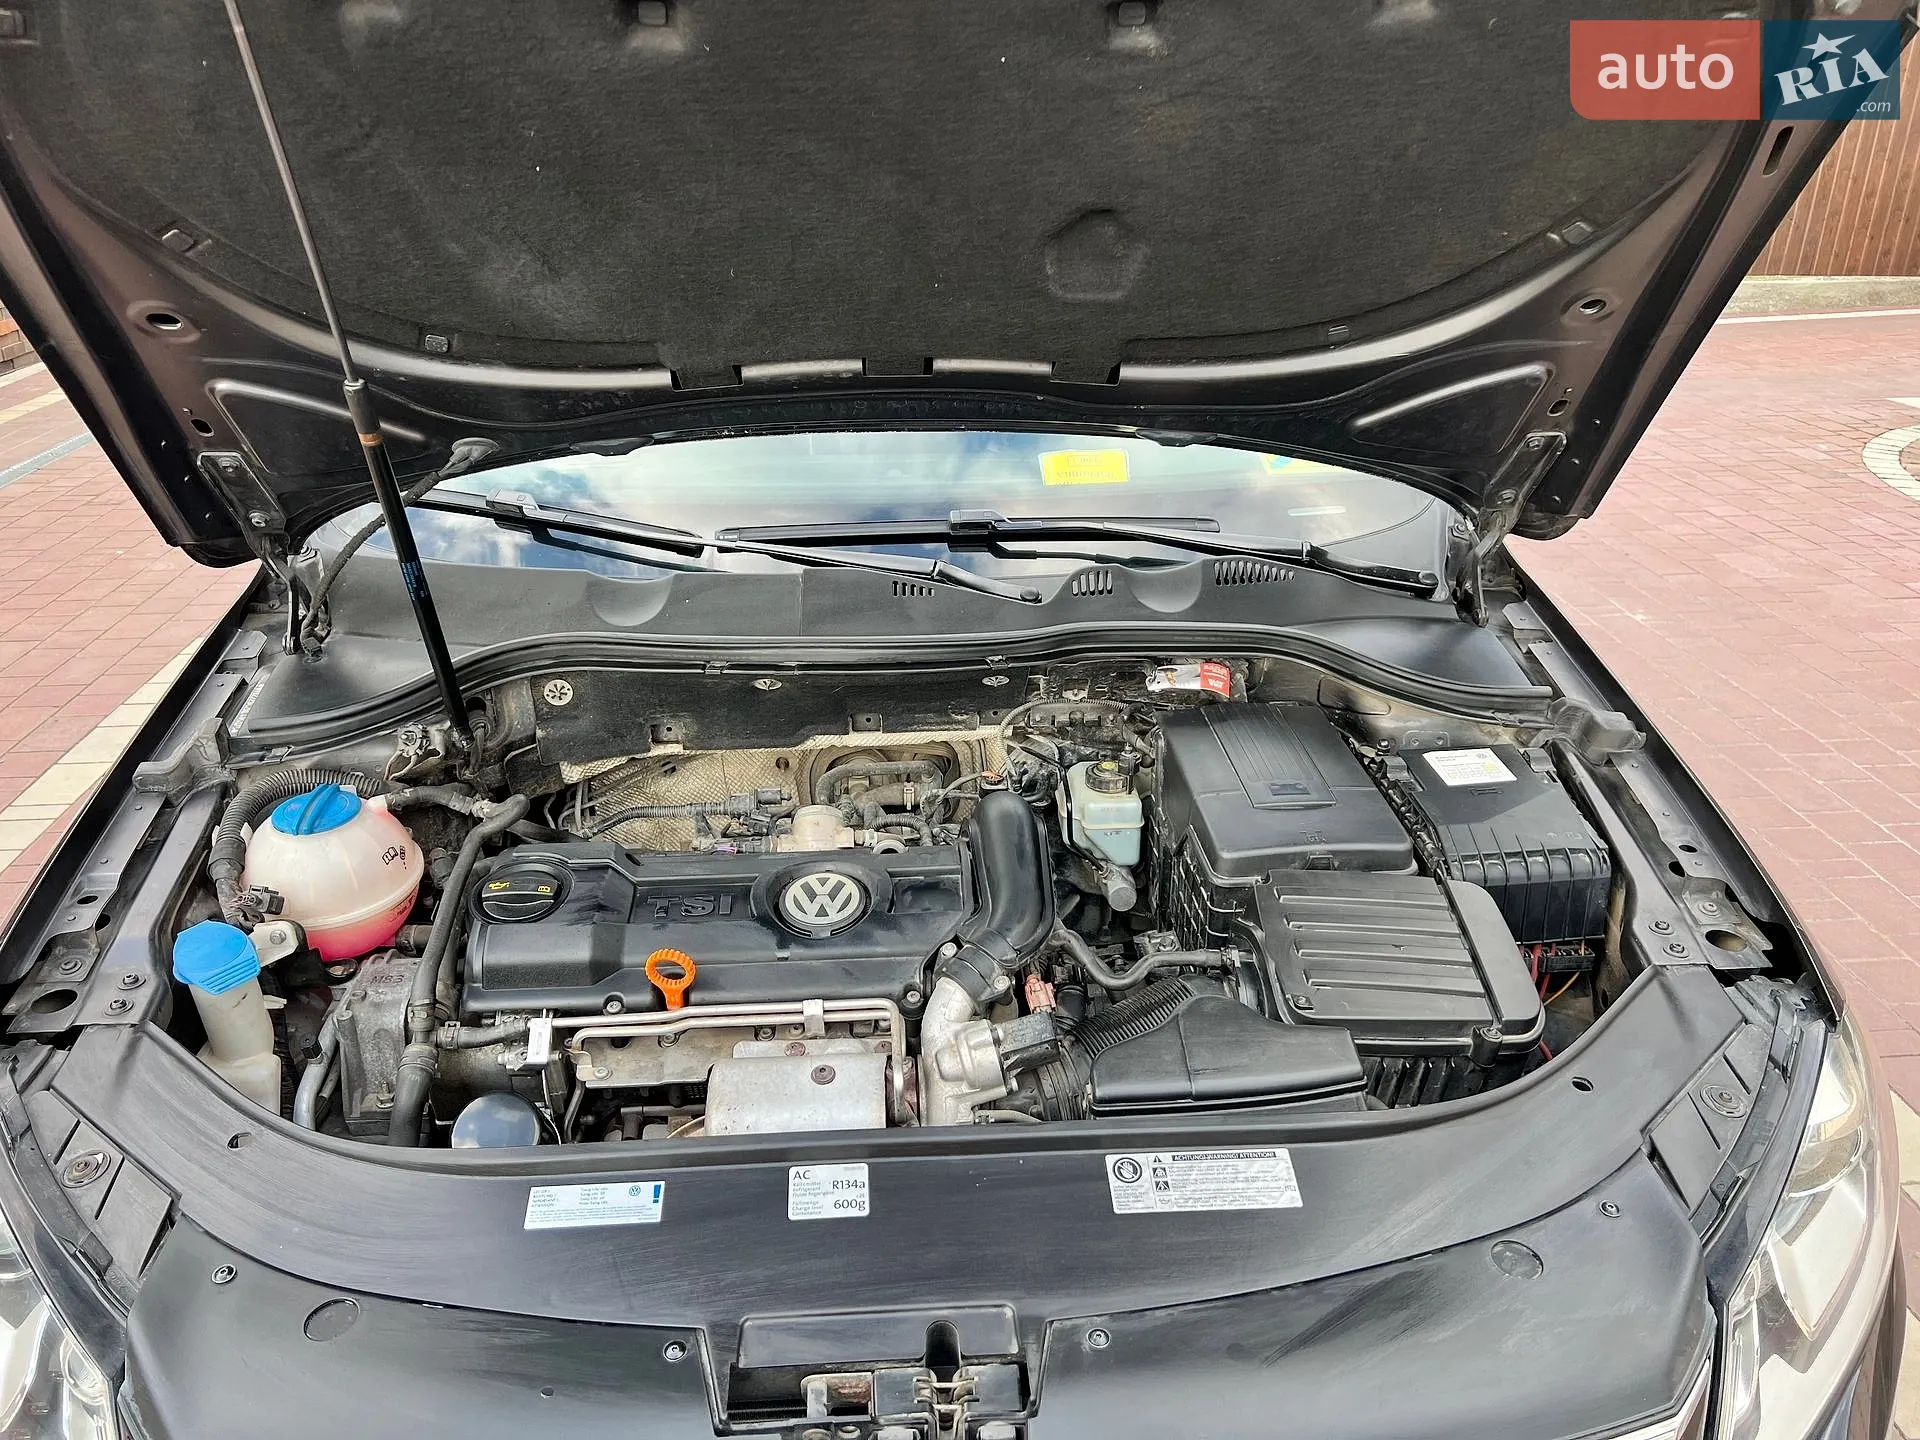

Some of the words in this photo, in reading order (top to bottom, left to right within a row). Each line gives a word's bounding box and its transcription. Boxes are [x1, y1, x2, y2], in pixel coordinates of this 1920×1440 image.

[647, 893, 733, 918] TSI
[793, 1170, 811, 1180] AC
[832, 1179, 866, 1190] R134a
[833, 1198, 866, 1211] 600g
